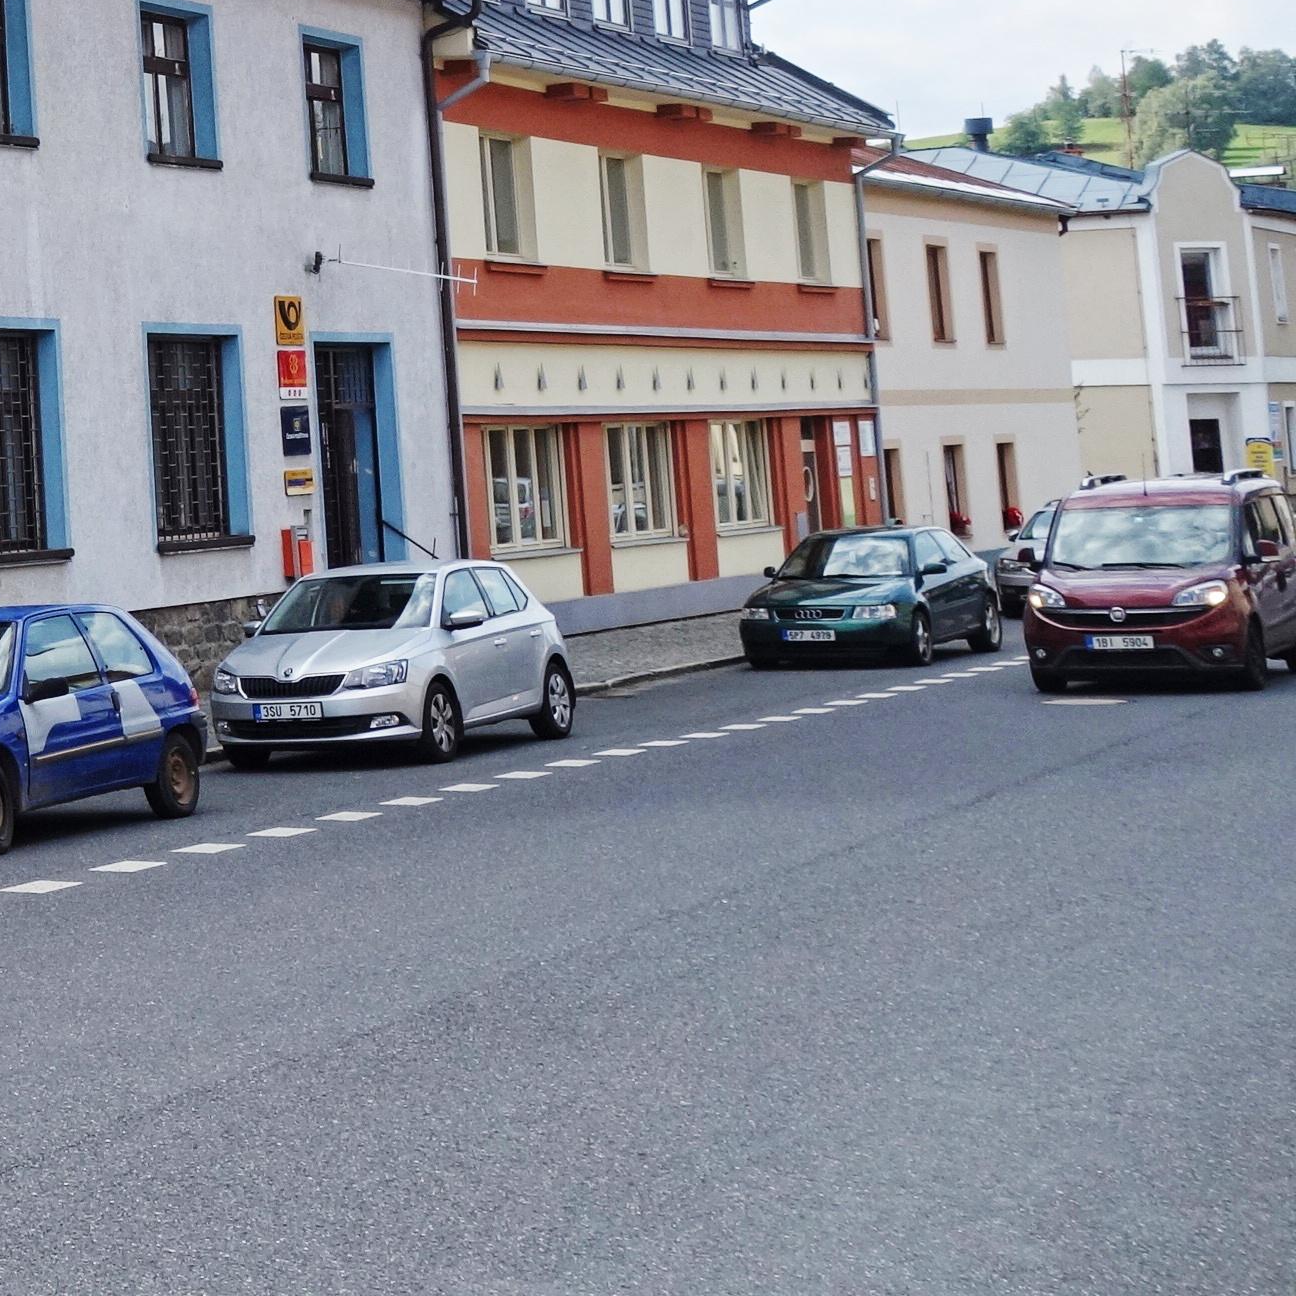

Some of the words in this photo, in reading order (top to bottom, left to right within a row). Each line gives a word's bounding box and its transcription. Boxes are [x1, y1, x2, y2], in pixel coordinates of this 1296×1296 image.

[1122, 637, 1148, 647] 5904
[263, 705, 282, 717] 3SU
[289, 704, 316, 717] 5710
